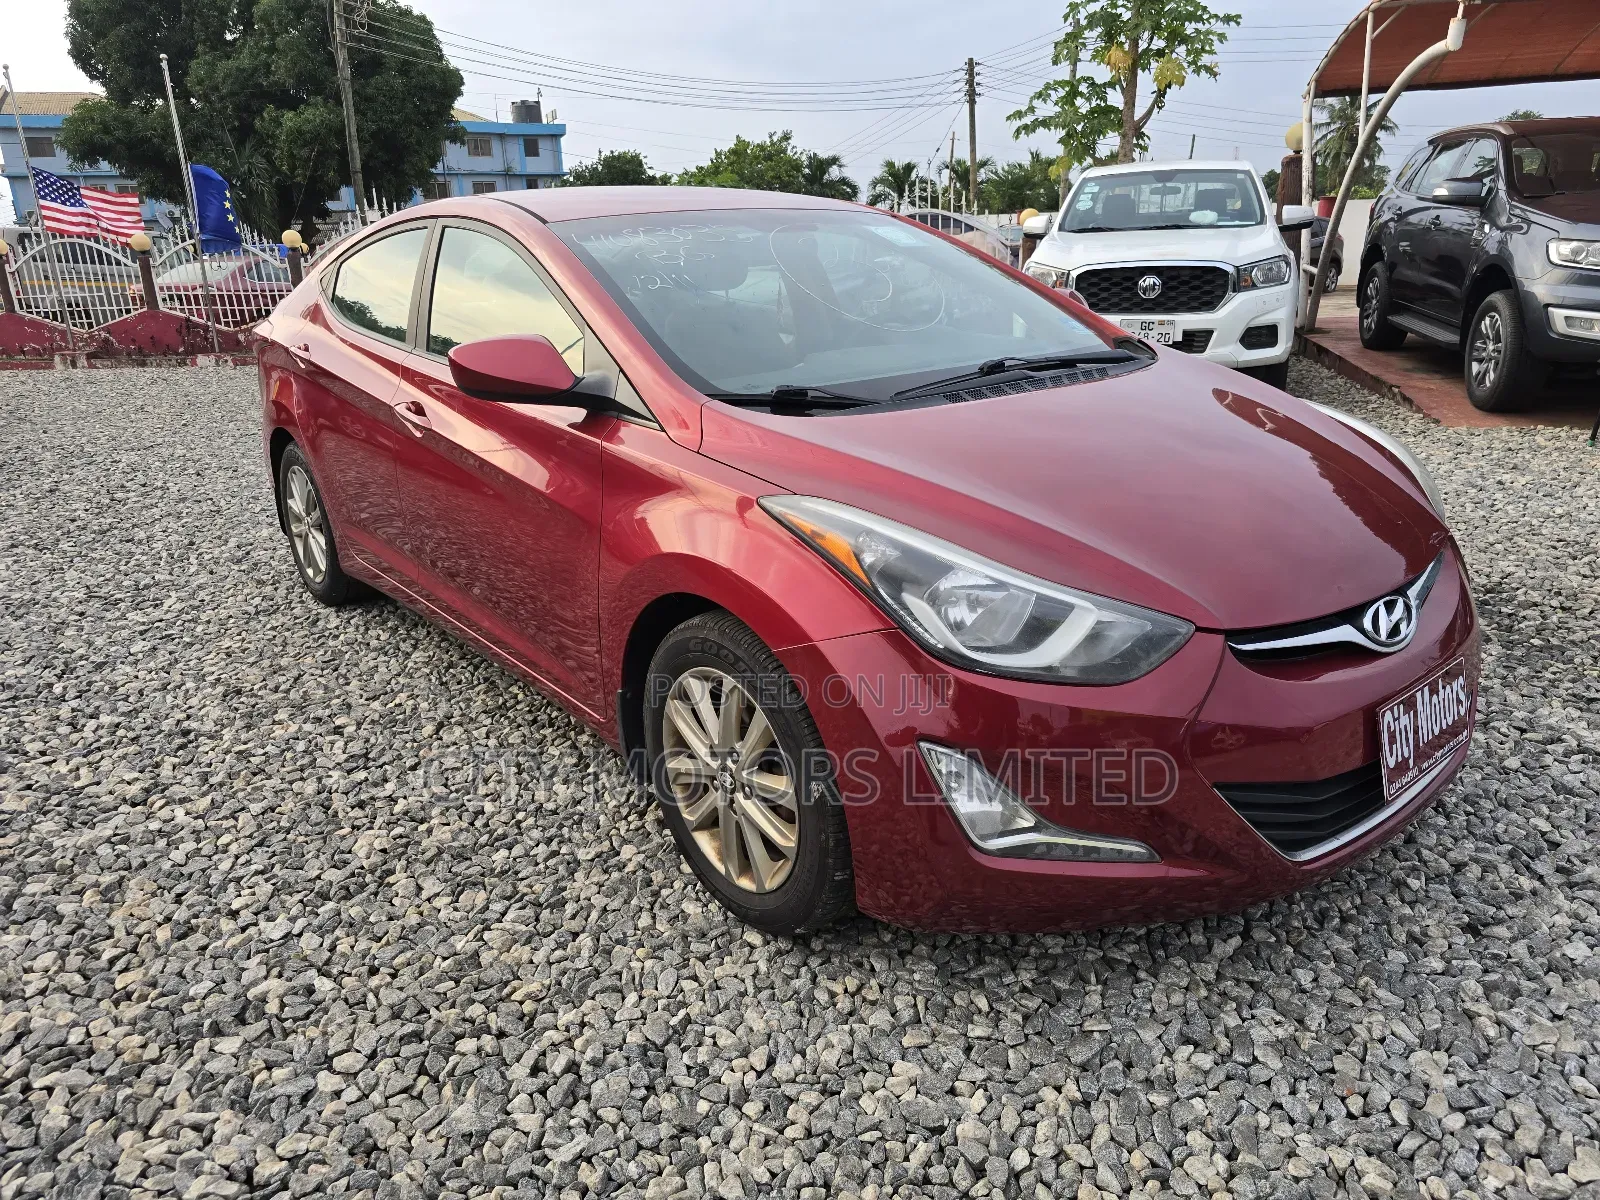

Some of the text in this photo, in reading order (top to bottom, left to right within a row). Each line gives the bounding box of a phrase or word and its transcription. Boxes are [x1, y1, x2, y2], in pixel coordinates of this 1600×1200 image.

[1140, 277, 1160, 297] MG
[1140, 321, 1155, 331] GC
[1383, 675, 1467, 769] City Motors
